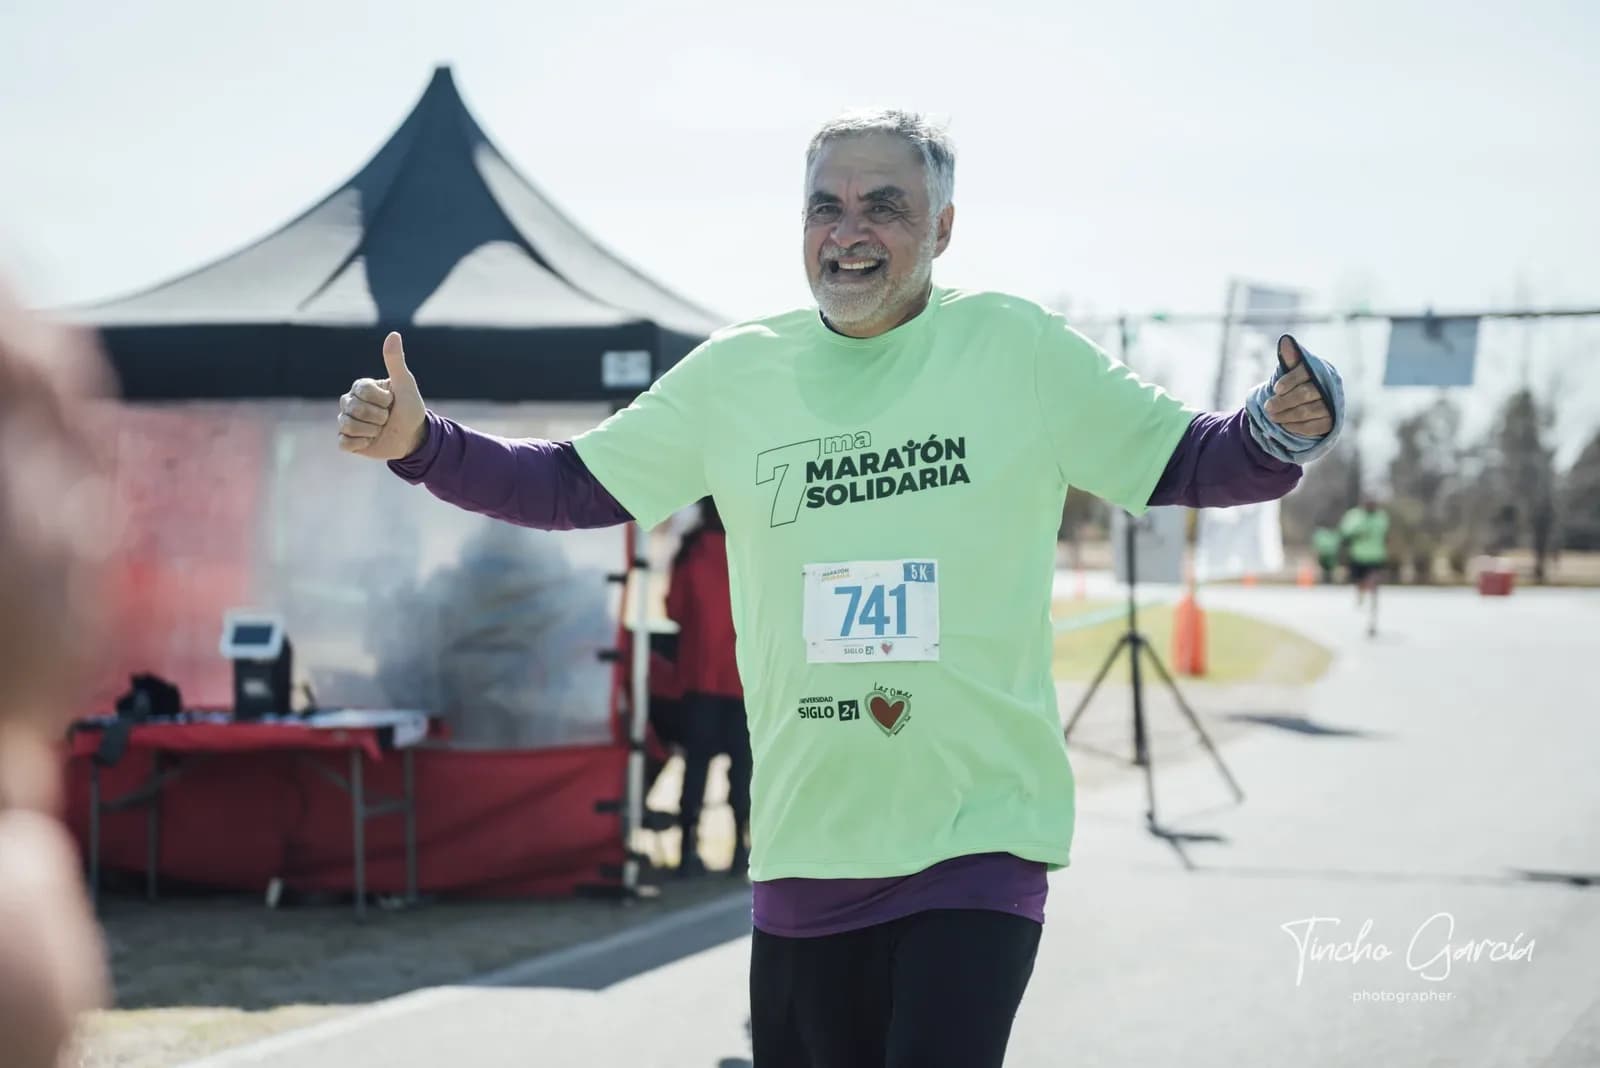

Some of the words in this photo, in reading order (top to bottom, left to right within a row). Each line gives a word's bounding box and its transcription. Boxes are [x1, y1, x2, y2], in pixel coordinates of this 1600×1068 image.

[806, 434, 966, 483] MARATÓN
[806, 463, 971, 509] SOLIDARIA
[911, 564, 928, 581] 5K
[835, 584, 907, 637] 741
[798, 706, 835, 719] SIGLO
[840, 702, 858, 721] 21
